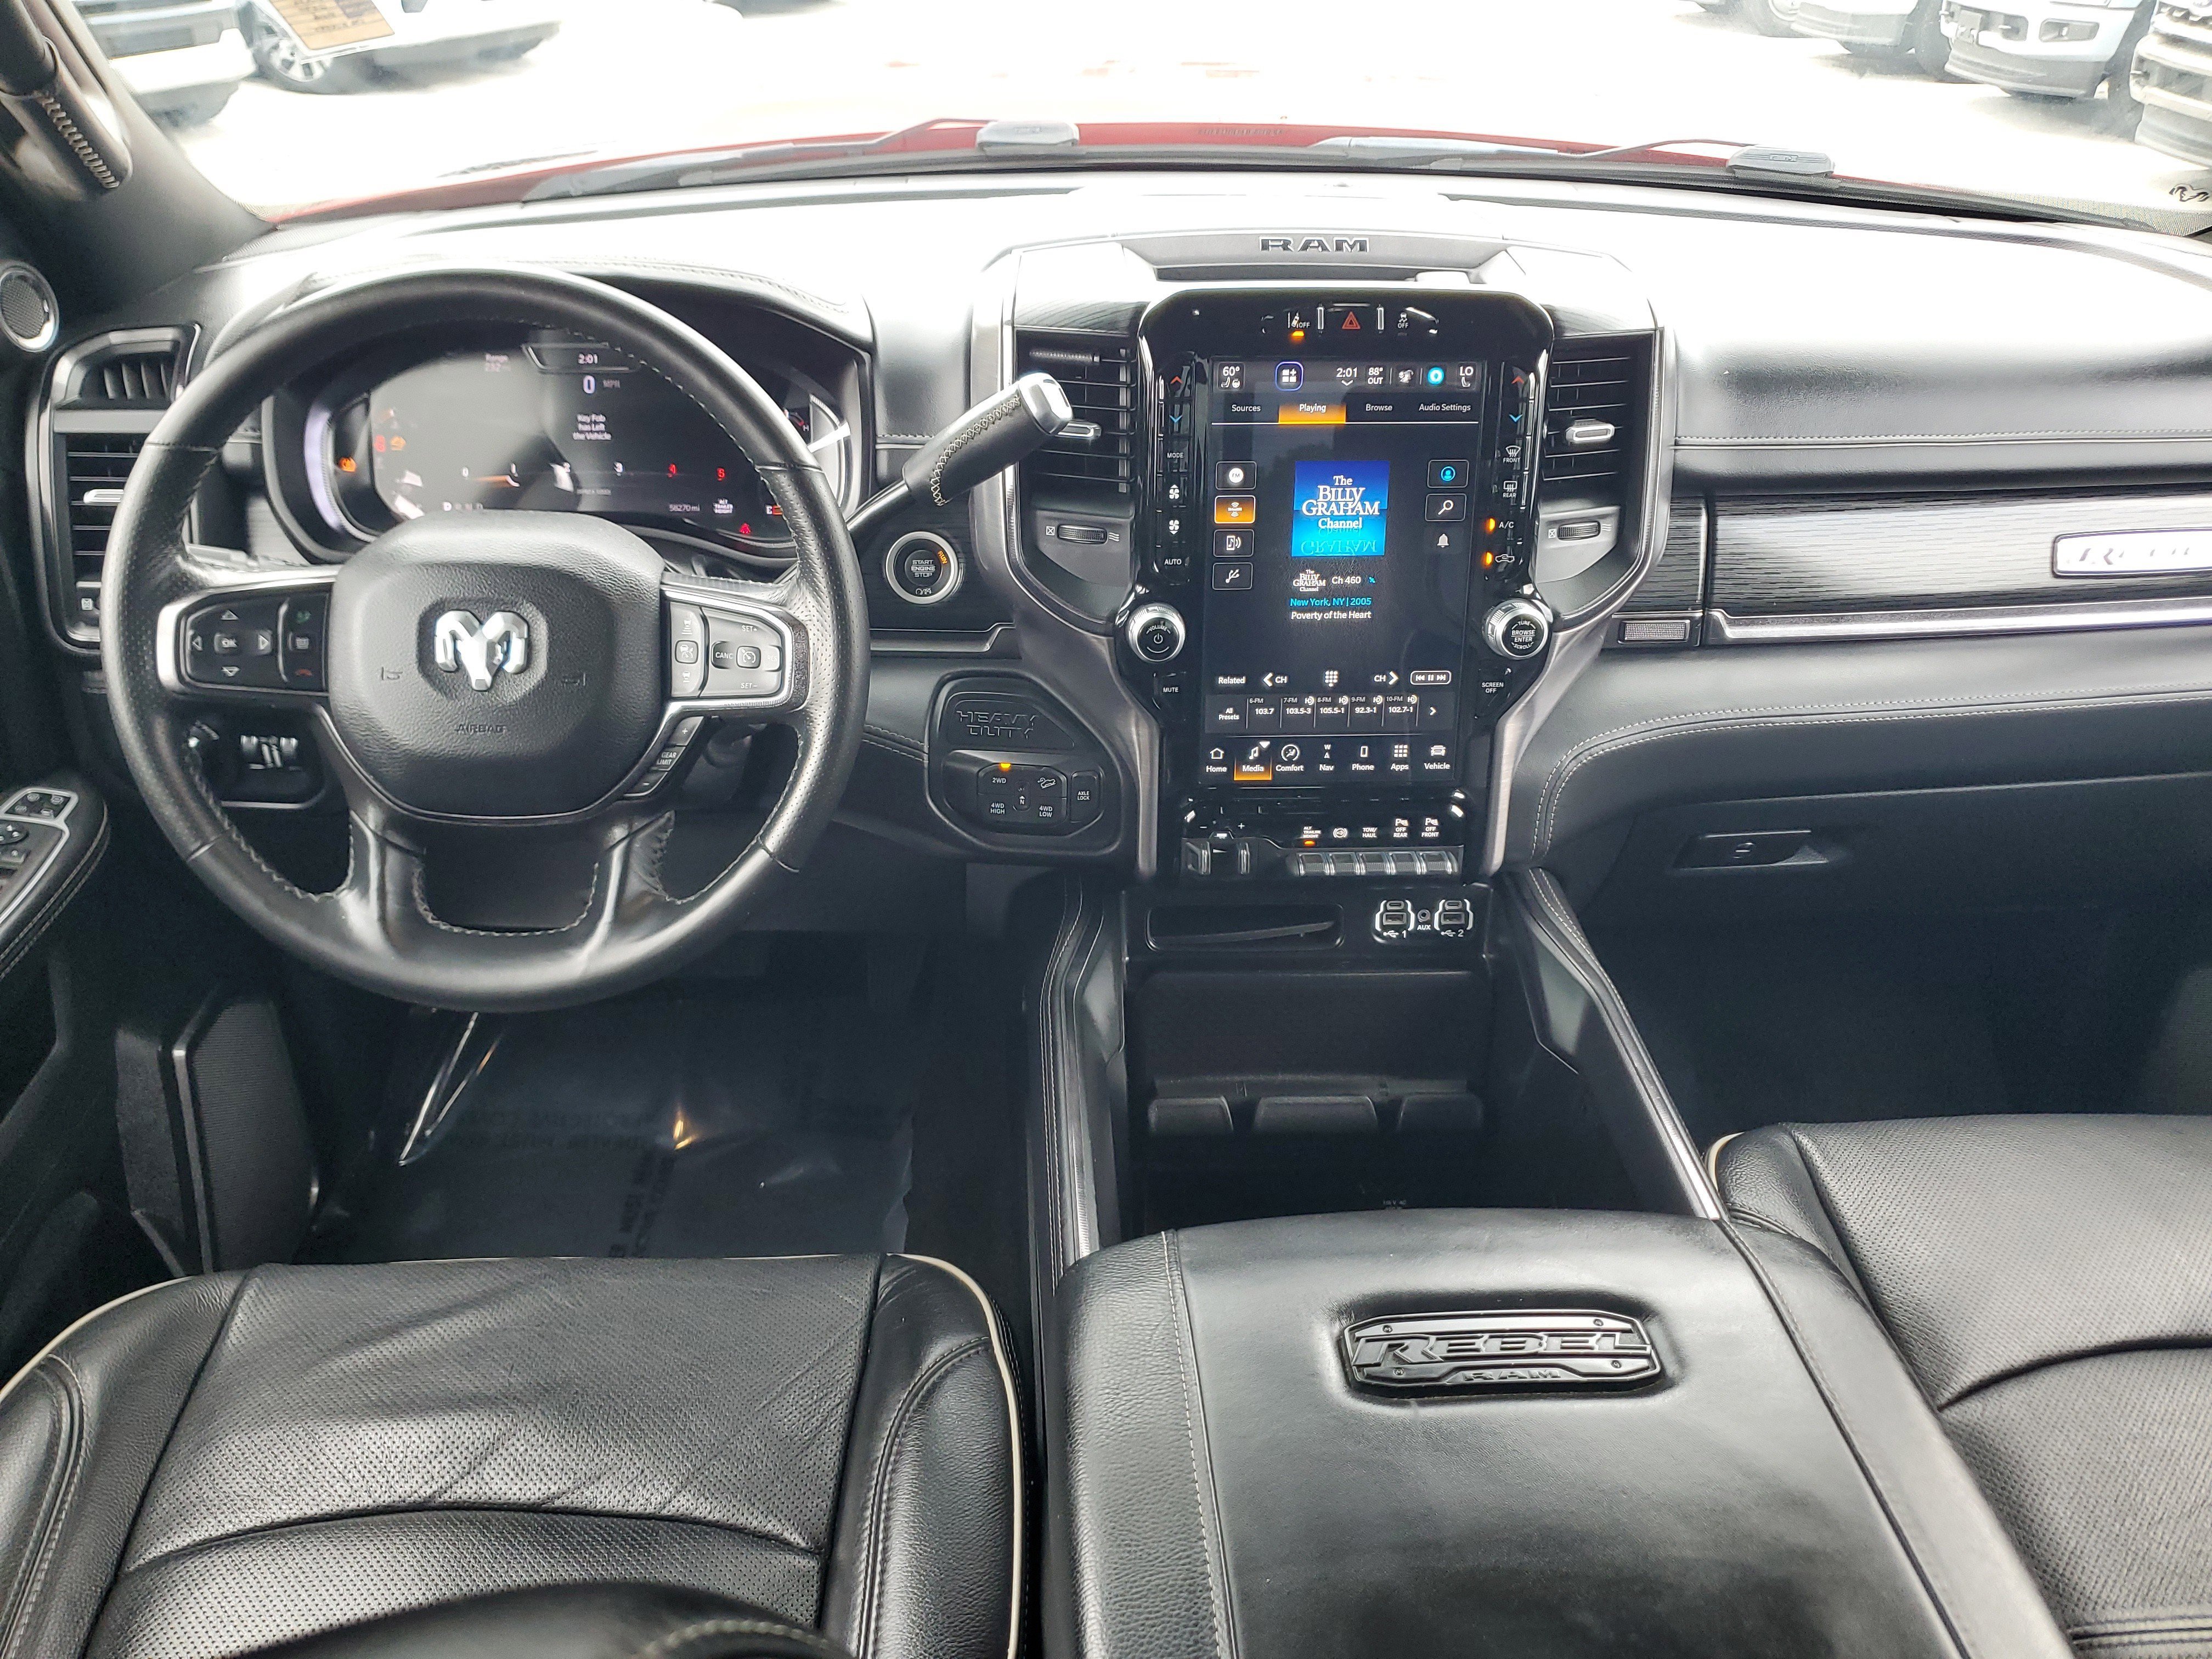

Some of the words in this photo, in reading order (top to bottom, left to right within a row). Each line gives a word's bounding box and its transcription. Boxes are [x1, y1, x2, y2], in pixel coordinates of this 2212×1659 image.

[1260, 236, 1369, 253] RAM
[1336, 367, 1358, 377] 2:01
[1459, 366, 1474, 376] LO
[583, 375, 595, 393] 0
[1299, 403, 1327, 413] Playing
[1441, 404, 1471, 413] Settings
[1333, 475, 1353, 486] The
[1317, 485, 1366, 505] BILLY
[1302, 499, 1381, 516] GRAHAM
[1318, 517, 1363, 529] Channel
[938, 550, 948, 564] RUN
[1331, 576, 1343, 584] Ch
[1344, 576, 1362, 584] 460
[1290, 597, 1308, 606] New
[1310, 597, 1331, 607] York,
[1333, 597, 1345, 606] NY
[1350, 597, 1372, 606] 2005
[1291, 611, 1323, 621] Poverty
[1323, 610, 1333, 619] of
[1333, 611, 1347, 619] the
[1348, 610, 1372, 619] Heart
[715, 651, 734, 659] CANC
[1218, 676, 1245, 685] Related
[1374, 674, 1386, 682] CH
[1390, 763, 1409, 771] Apps
[1402, 929, 1407, 938] 1
[1458, 929, 1464, 938] 2
[1352, 1333, 1651, 1367] REBEL
[1463, 1369, 1560, 1382] RAM
